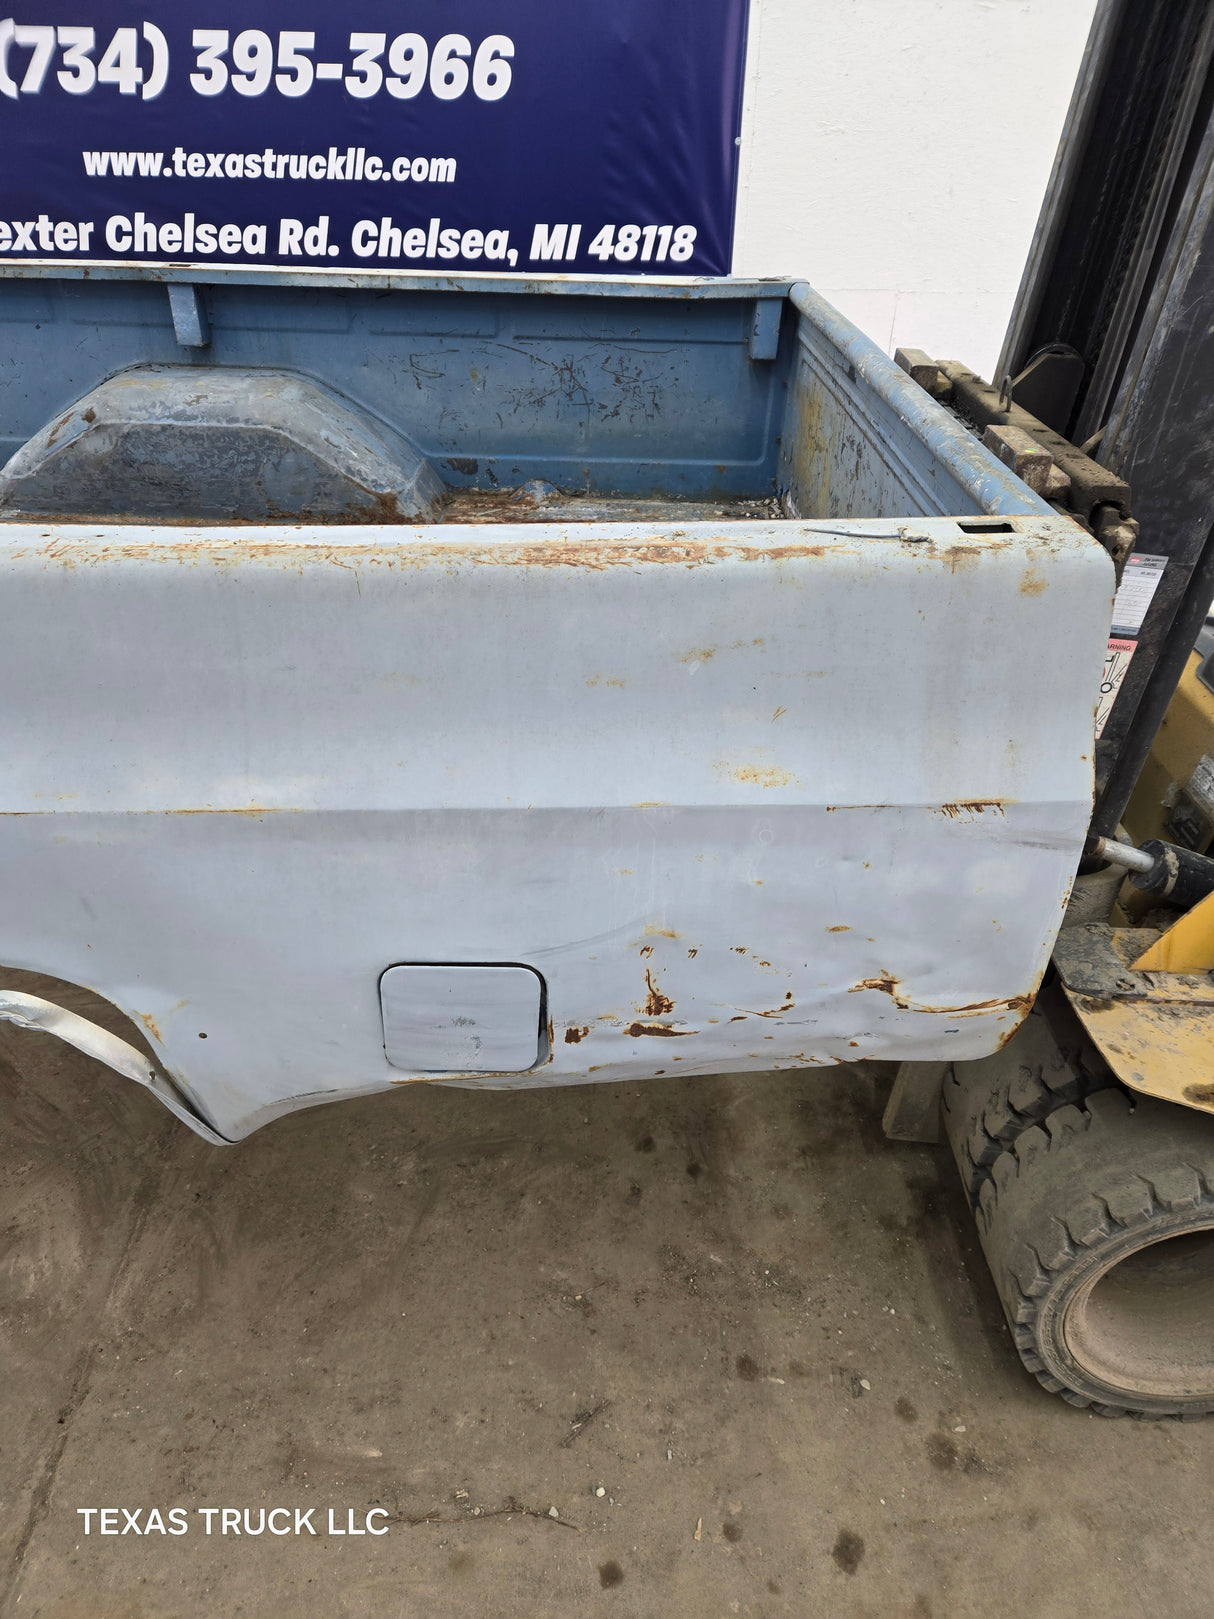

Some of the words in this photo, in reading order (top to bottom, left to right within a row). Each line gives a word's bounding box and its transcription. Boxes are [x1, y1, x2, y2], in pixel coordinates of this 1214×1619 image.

[0, 18, 170, 101] (734)
[190, 30, 515, 101] 395-3966
[83, 147, 457, 183] www.texastruckllc.com
[106, 212, 267, 256] Chelsea
[279, 217, 340, 258] Rd.
[352, 216, 519, 267] Chelsea,
[530, 223, 579, 261] MI
[588, 225, 698, 262] 48118
